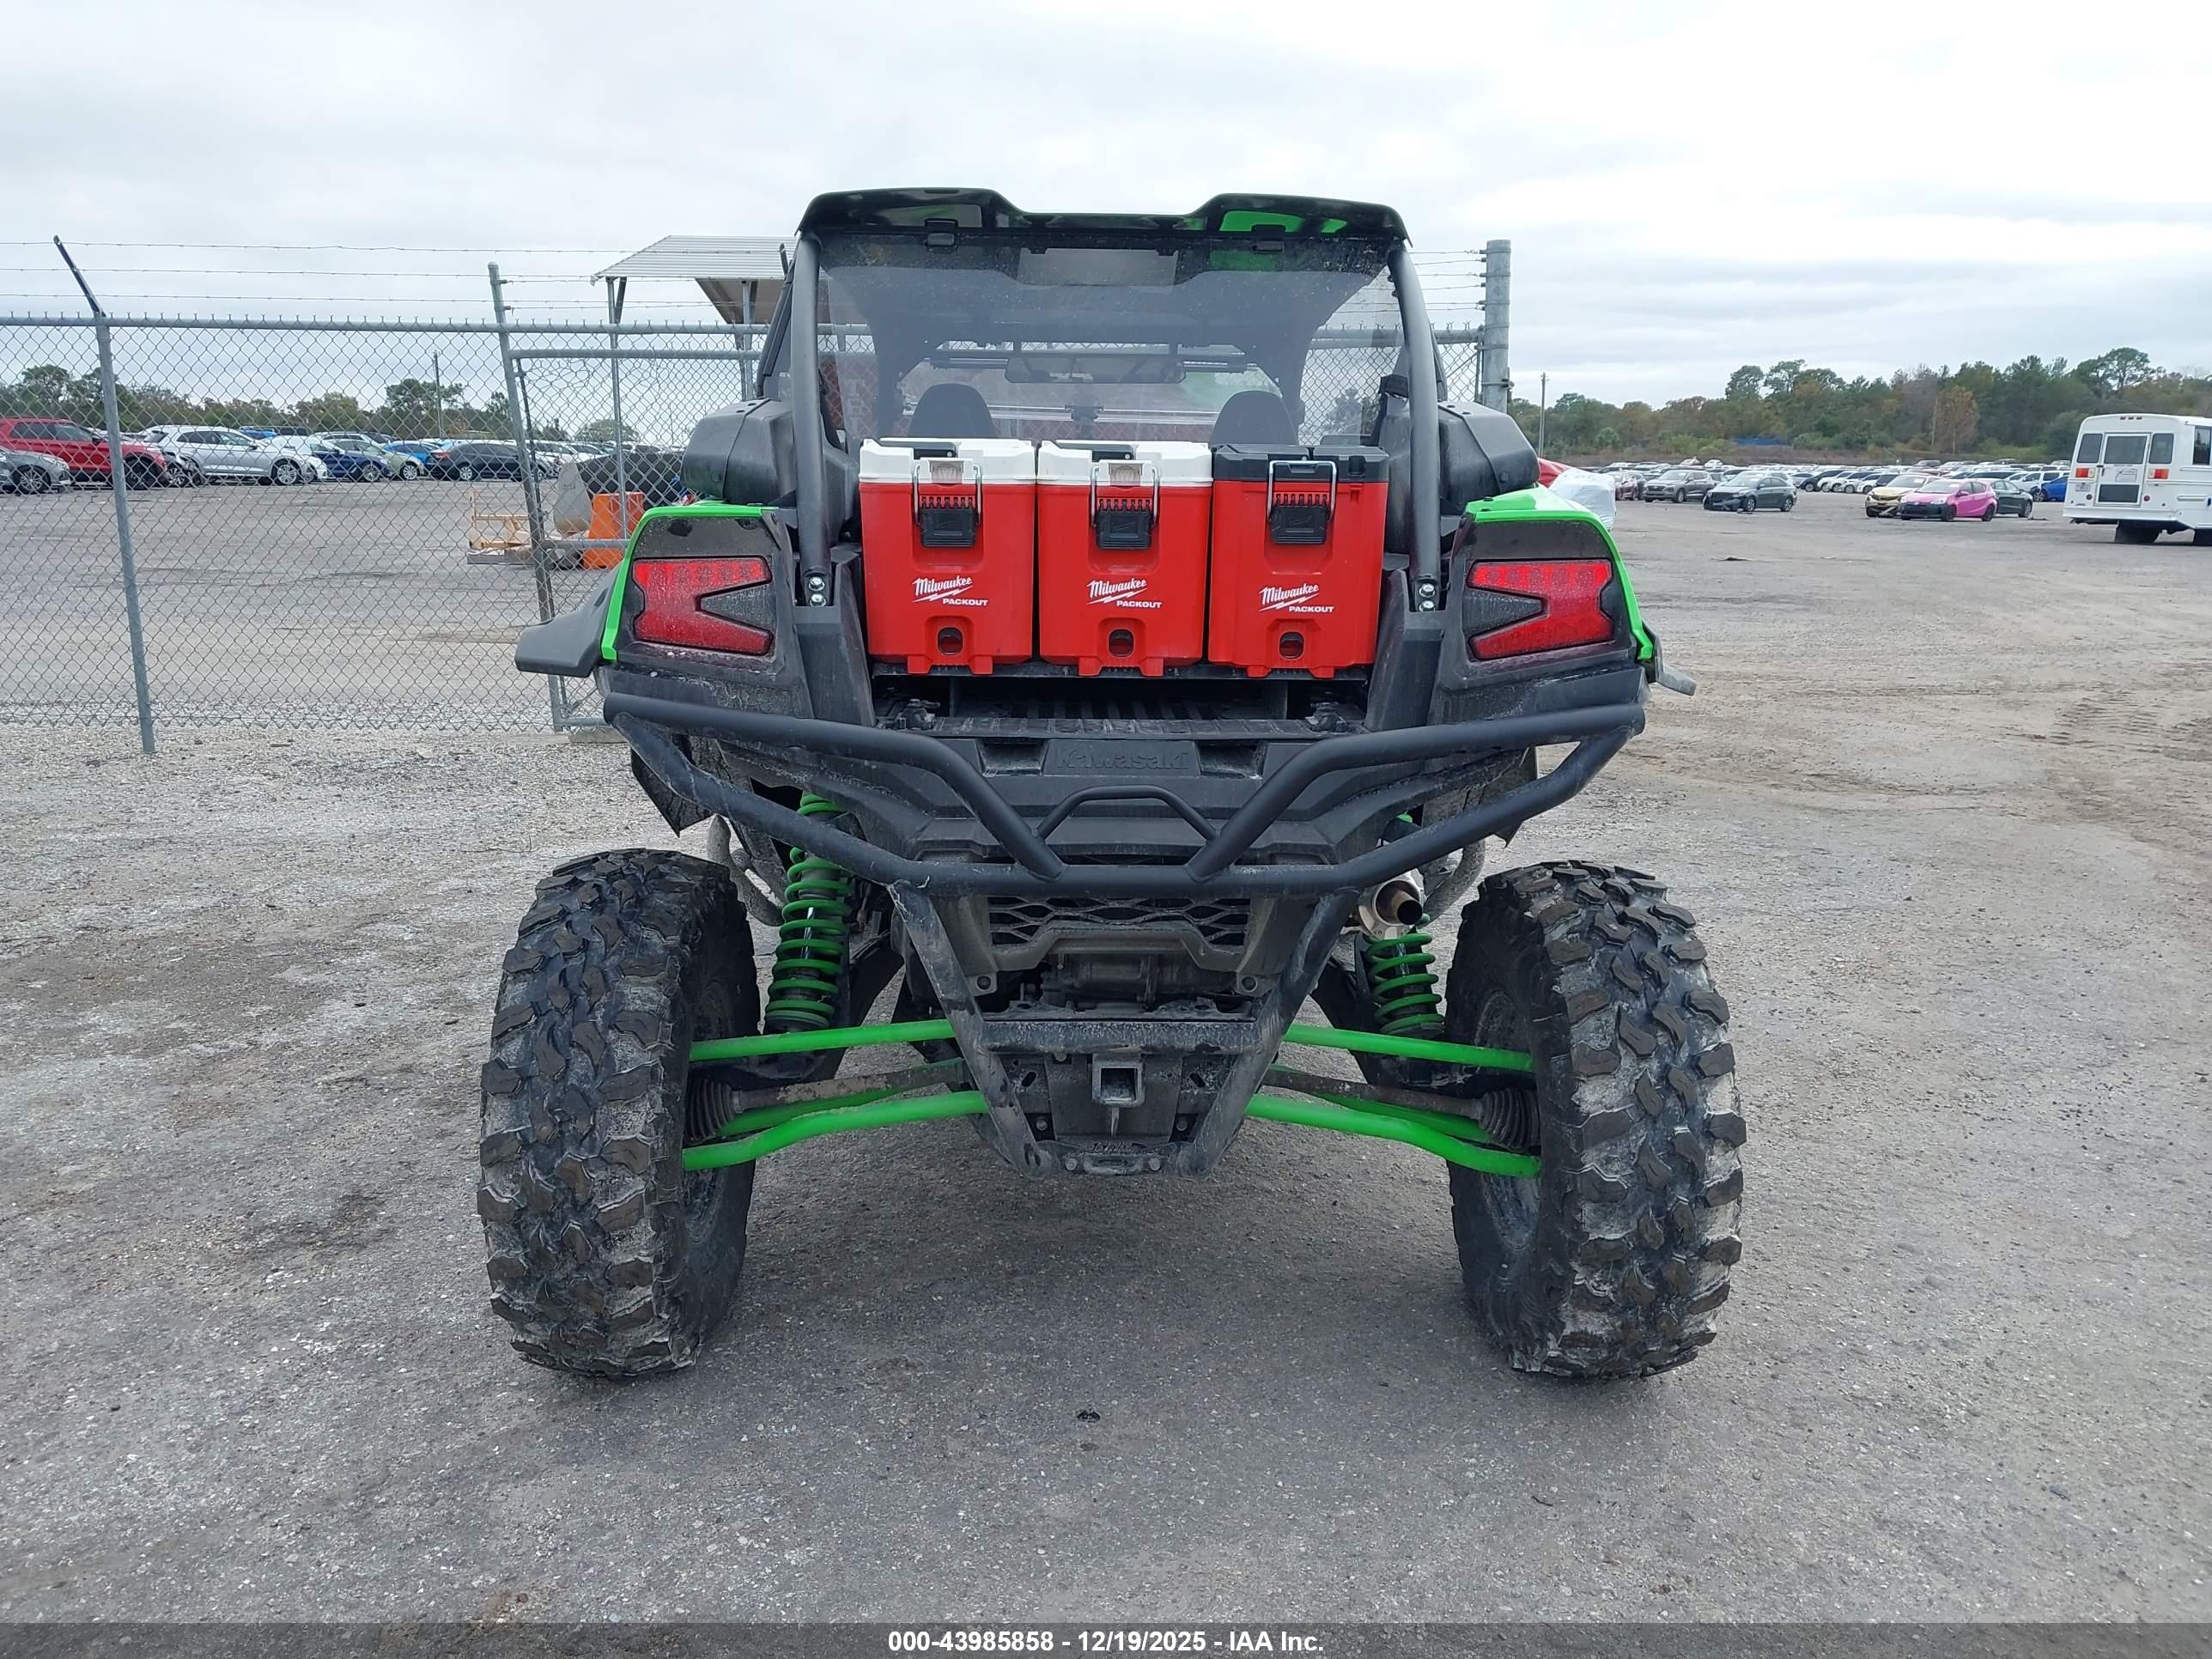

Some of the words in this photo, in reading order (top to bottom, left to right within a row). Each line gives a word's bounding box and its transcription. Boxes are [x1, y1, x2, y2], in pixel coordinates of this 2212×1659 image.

[912, 575, 973, 597] Milwaukee
[1086, 578, 1147, 599] Milwaukee
[1259, 583, 1320, 605] Milwaukee
[1055, 746, 1189, 770] Kawasaki
